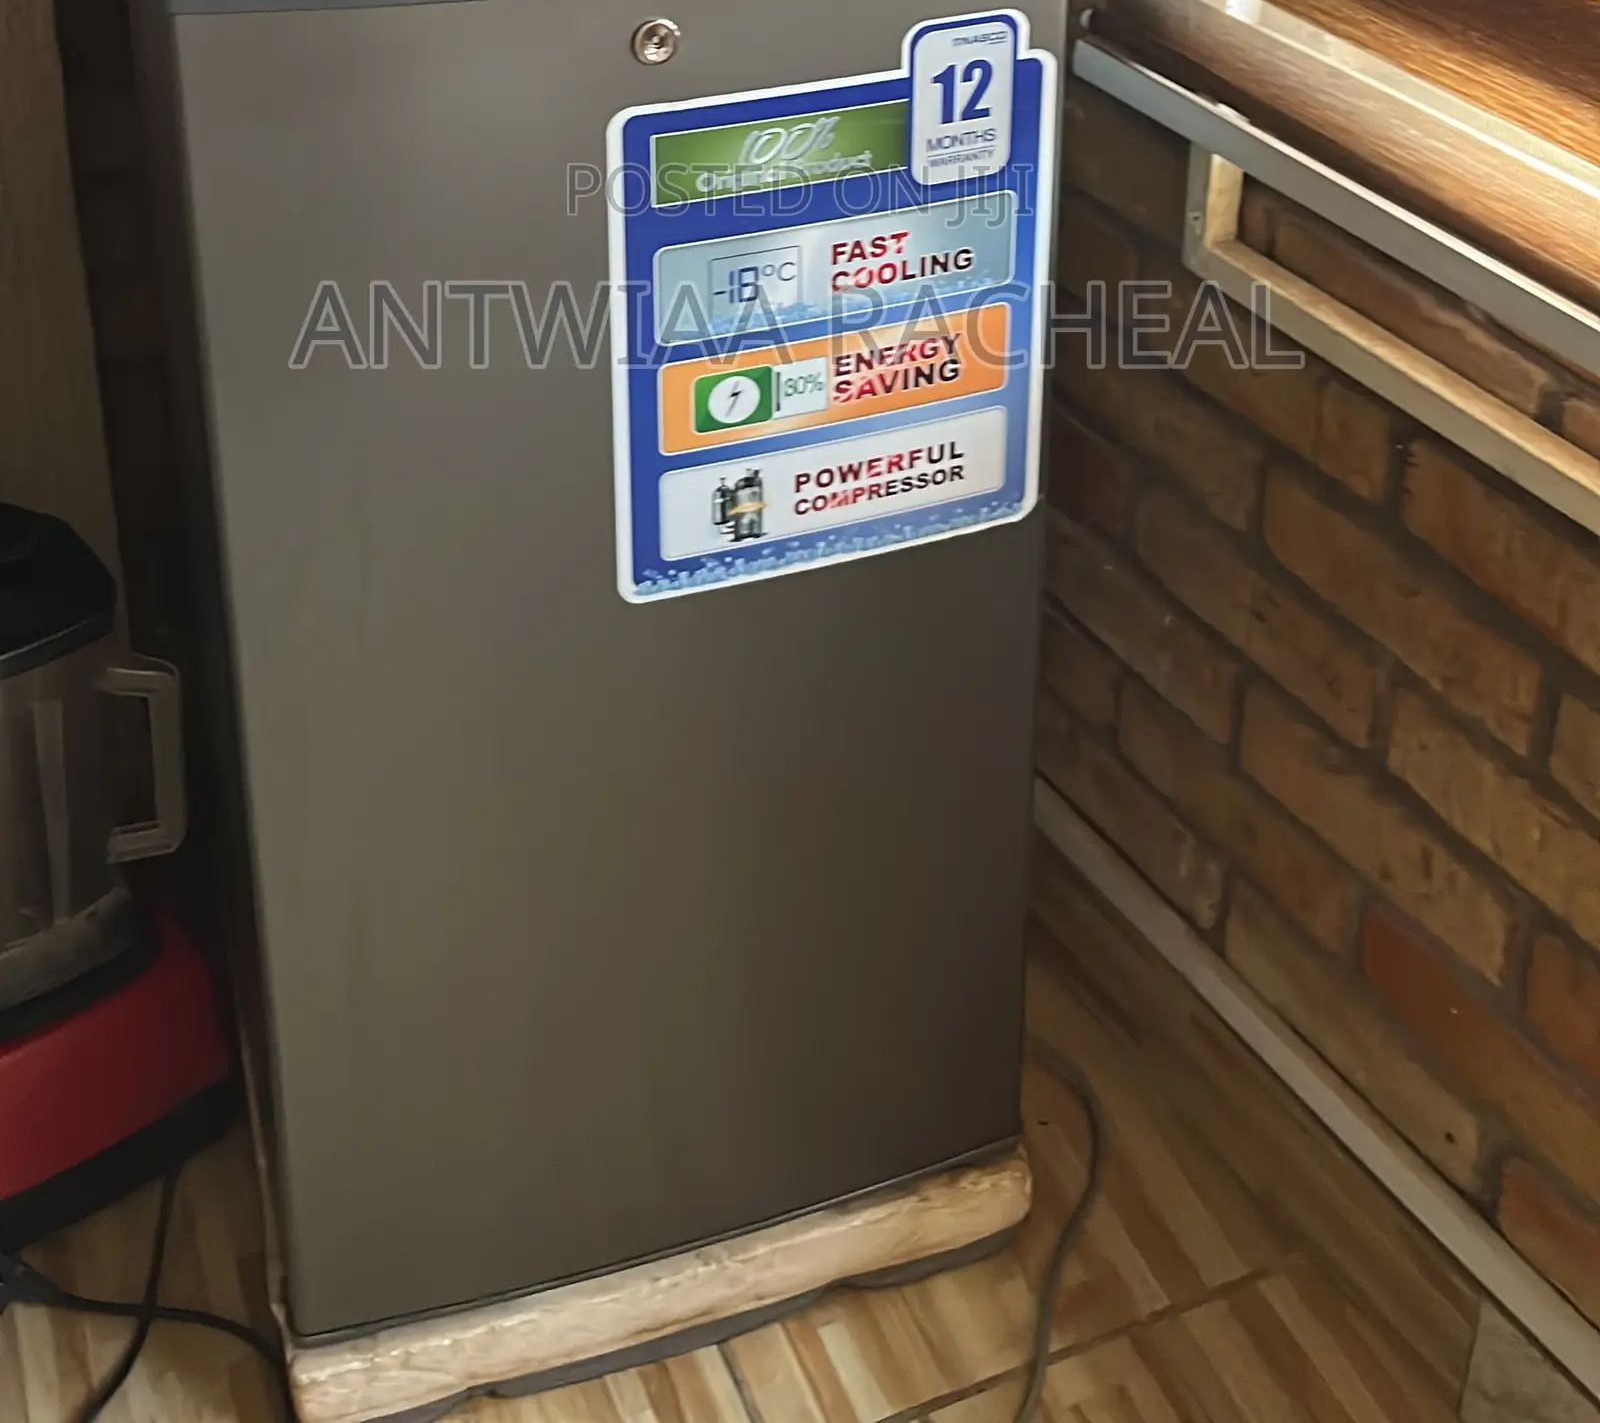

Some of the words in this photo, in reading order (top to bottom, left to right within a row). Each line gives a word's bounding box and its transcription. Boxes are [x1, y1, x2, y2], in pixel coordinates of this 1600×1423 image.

[931, 59, 993, 125] 12
[738, 116, 840, 166] 100%
[926, 128, 997, 152] MONTHS
[929, 149, 996, 168] WARRANTY
[831, 231, 909, 266] FAST
[831, 248, 974, 293] COOLING
[833, 333, 962, 378] ENERGY
[783, 371, 824, 397] 30%
[833, 359, 961, 403] SAVING
[794, 441, 965, 494] POWERFUL
[794, 465, 966, 516] COMPRESSOR
